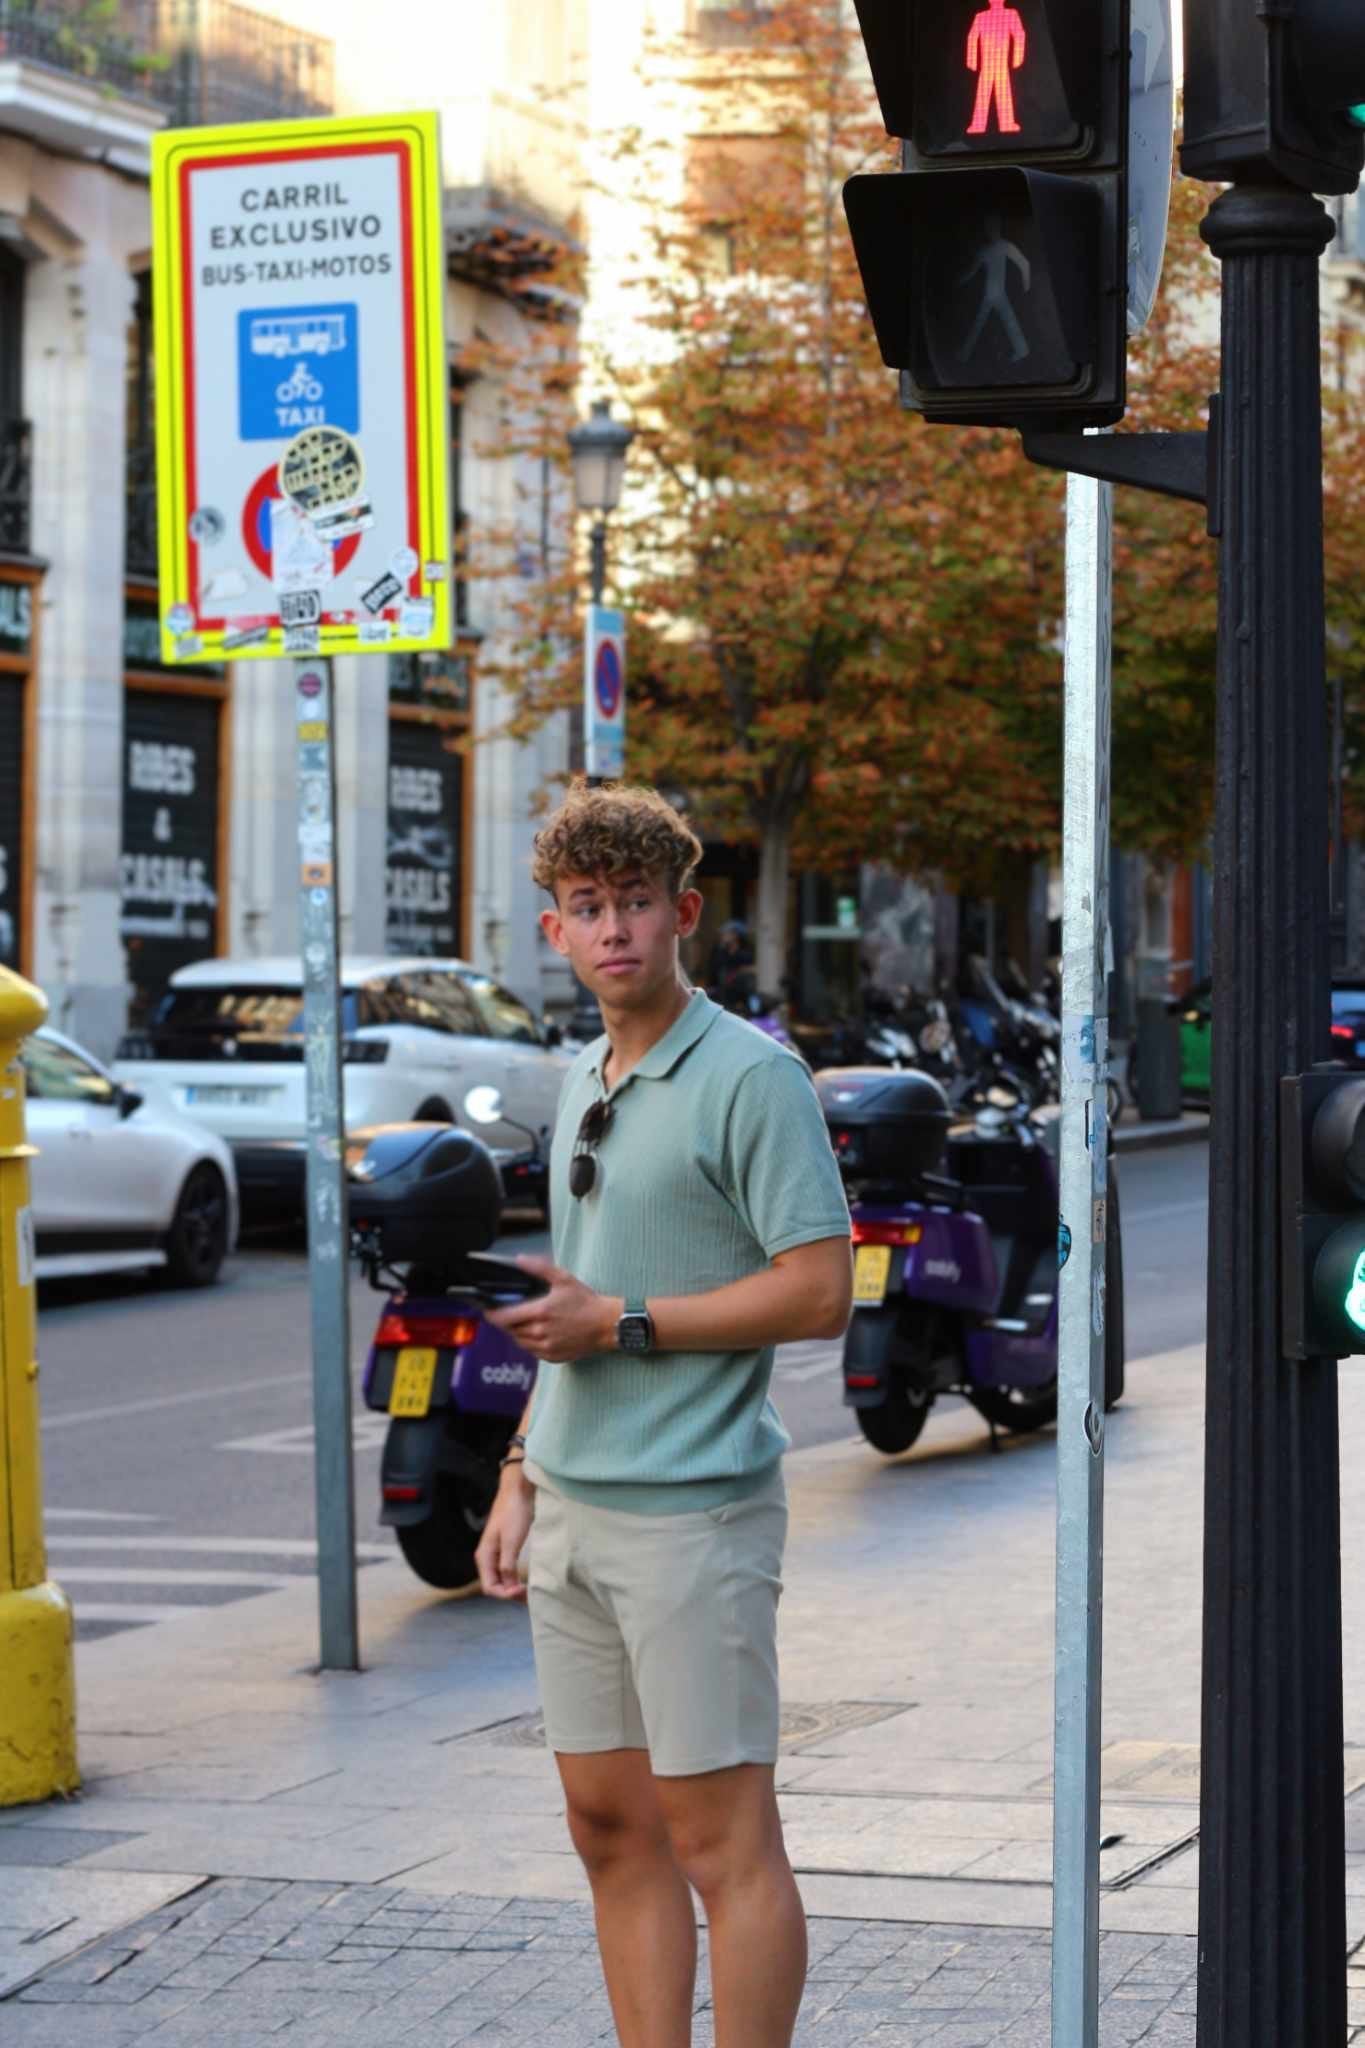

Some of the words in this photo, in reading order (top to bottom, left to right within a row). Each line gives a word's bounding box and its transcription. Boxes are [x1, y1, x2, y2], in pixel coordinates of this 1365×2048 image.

[240, 183, 349, 212] CARRIL
[210, 215, 381, 249] EXCLUSIVO
[202, 253, 392, 287] BUS-TAXI-MOTOS
[275, 405, 325, 428] TAXI
[481, 1362, 531, 1391] cabify
